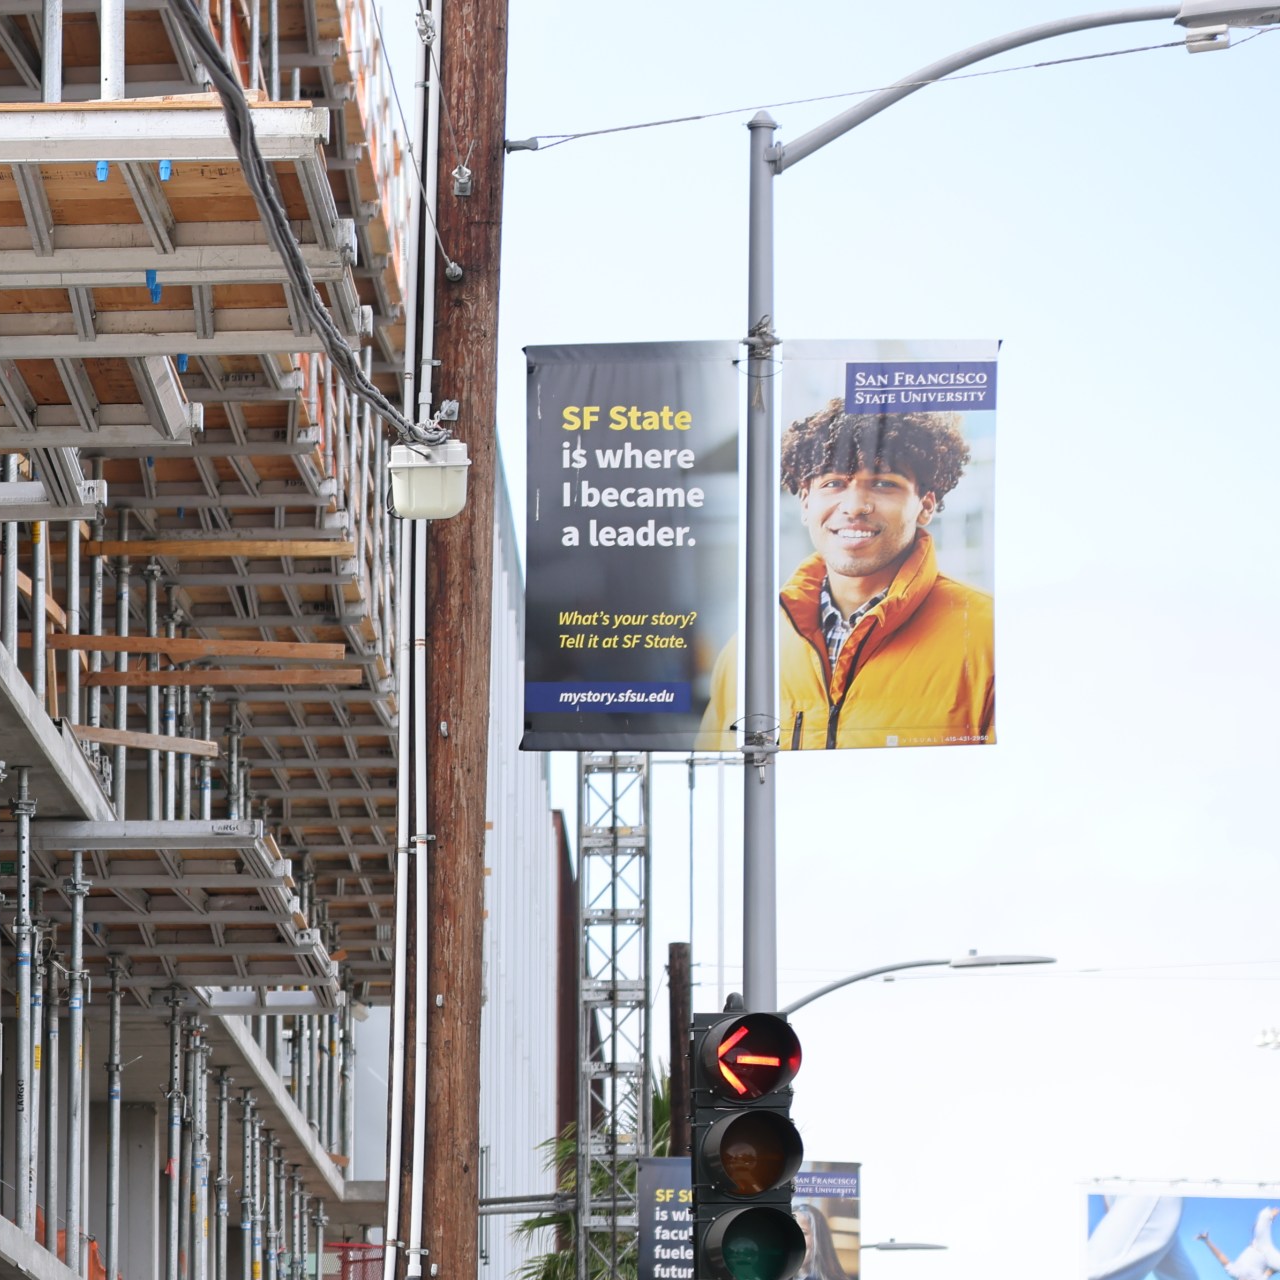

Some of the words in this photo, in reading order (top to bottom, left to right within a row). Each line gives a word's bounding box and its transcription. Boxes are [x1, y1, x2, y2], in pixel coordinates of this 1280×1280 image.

[854, 370, 890, 388] SAN
[893, 369, 989, 387] FRANCISCO
[854, 390, 897, 405] STATE
[899, 388, 987, 405] UNIVERSITY
[561, 405, 600, 431] SF
[609, 405, 693, 431] State
[561, 442, 587, 469] is
[595, 442, 696, 469] where
[561, 482, 572, 508] I
[580, 481, 706, 509] became
[561, 524, 580, 547] a
[588, 520, 697, 548] leader.
[558, 610, 609, 627] What's
[613, 613, 648, 631] your
[651, 611, 698, 631] story?
[558, 633, 584, 650] Tell
[585, 634, 599, 650] it
[601, 636, 620, 650] at
[621, 633, 641, 650] SF
[643, 633, 688, 650] State.
[559, 688, 675, 705] mystory.sfsu.edu
[812, 1176, 857, 1185] FRANCISCO
[655, 1189, 675, 1203] SF
[815, 1186, 857, 1195] UNIVERSITY
[655, 1207, 668, 1222] is
